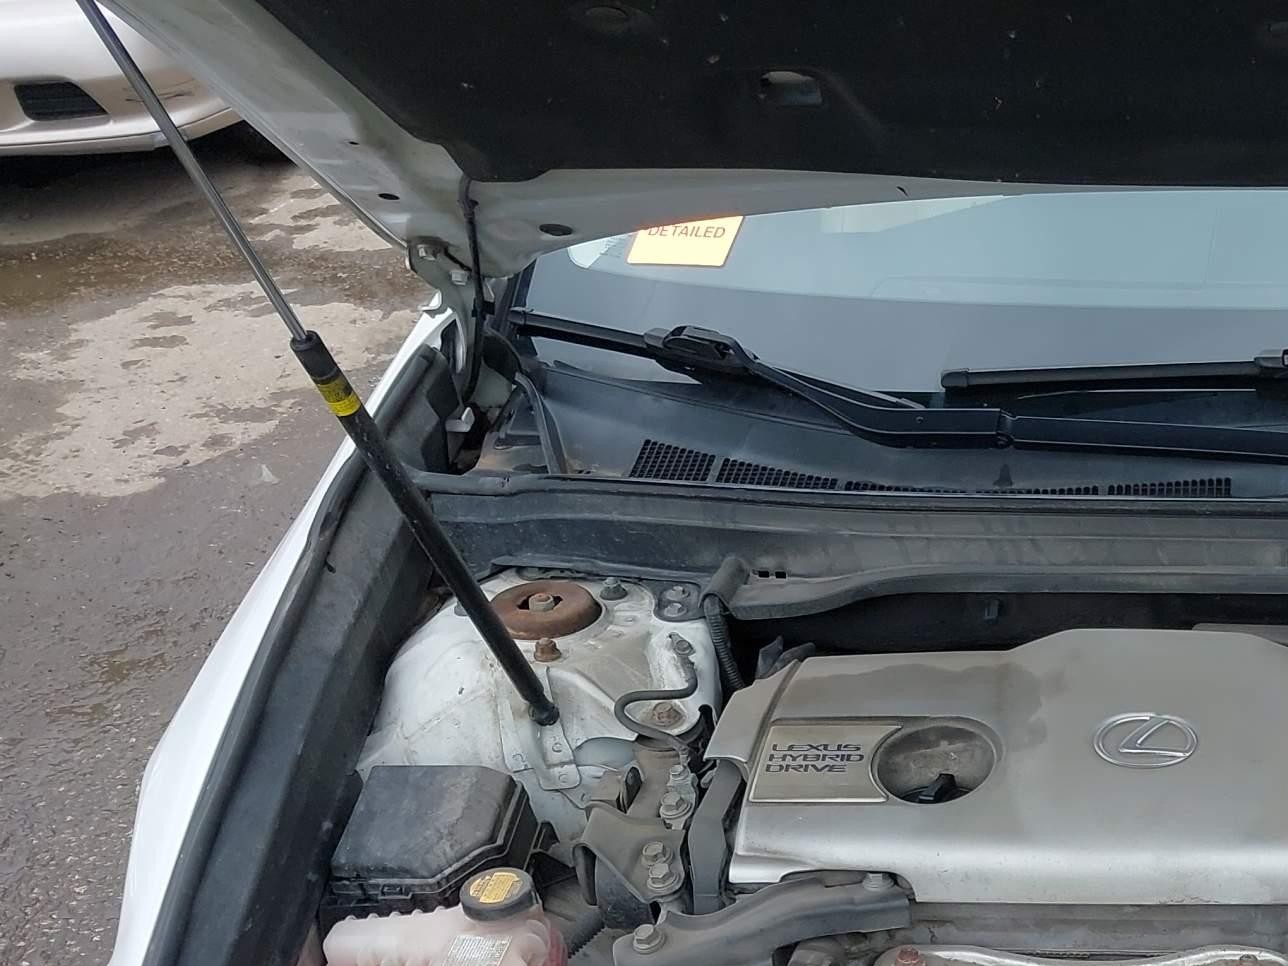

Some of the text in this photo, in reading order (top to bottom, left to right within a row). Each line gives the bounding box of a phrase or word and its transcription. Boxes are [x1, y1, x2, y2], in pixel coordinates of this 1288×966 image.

[648, 225, 726, 239] DETAILED
[772, 743, 861, 752] LEXUS
[768, 753, 865, 762] HYBRID
[765, 763, 848, 773] DRIVE
